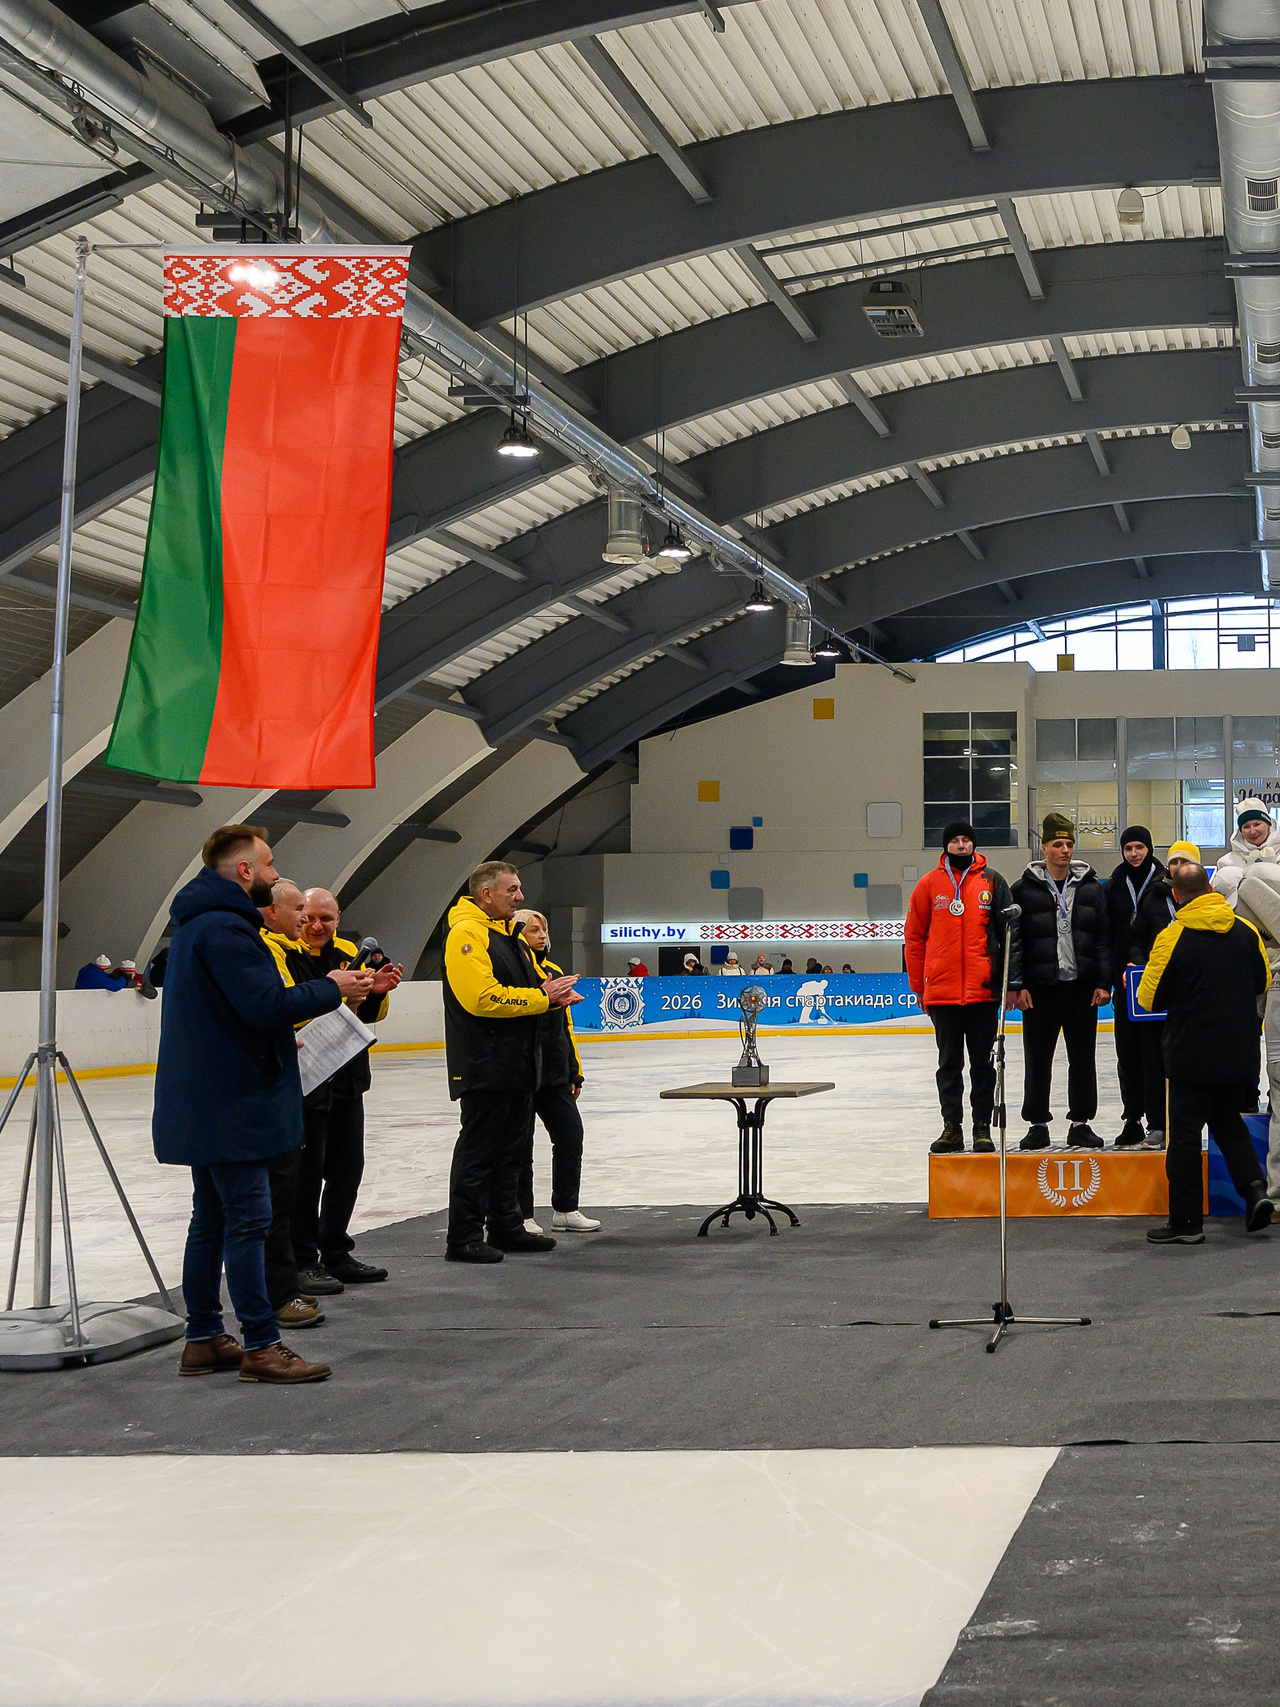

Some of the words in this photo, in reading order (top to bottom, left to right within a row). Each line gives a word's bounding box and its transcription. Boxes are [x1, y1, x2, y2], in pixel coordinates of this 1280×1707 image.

[610, 926, 686, 939] silichy.by
[489, 994, 528, 1006] BELARUS
[661, 994, 702, 1010] 2026
[785, 993, 893, 1009] спартакиада
[1053, 1160, 1084, 1191] II
